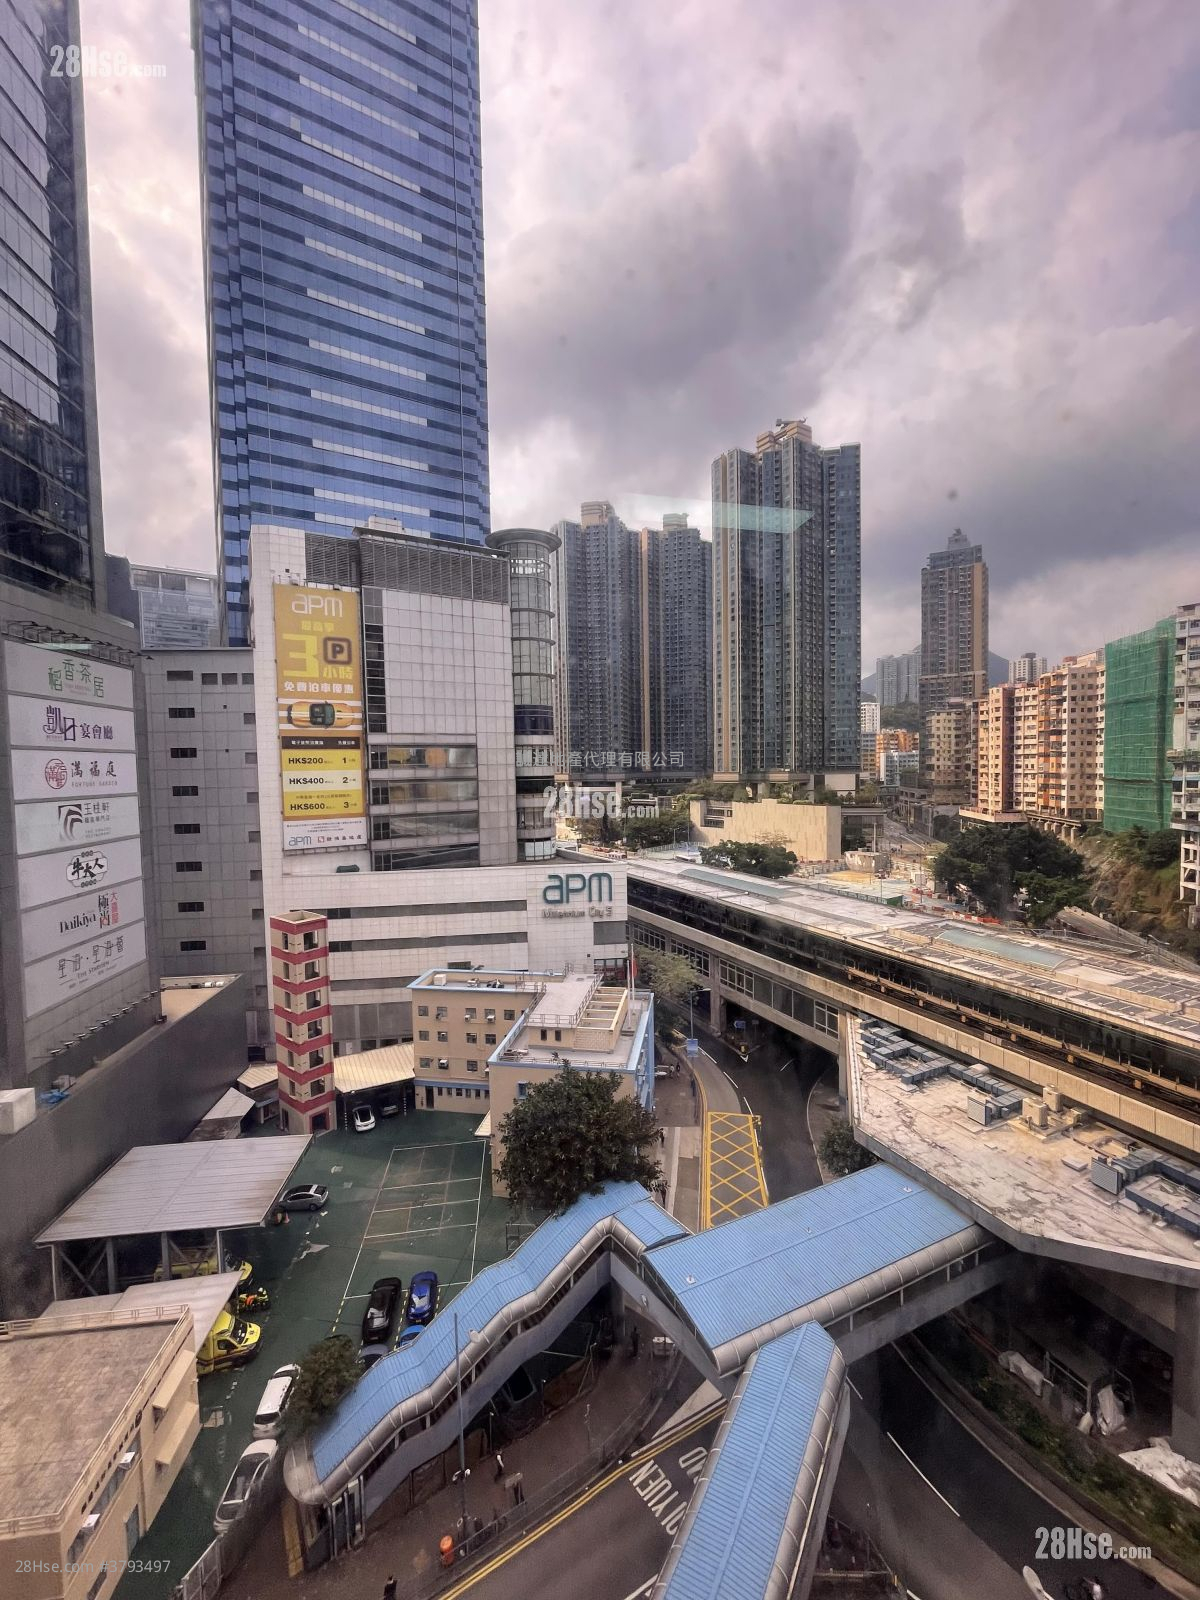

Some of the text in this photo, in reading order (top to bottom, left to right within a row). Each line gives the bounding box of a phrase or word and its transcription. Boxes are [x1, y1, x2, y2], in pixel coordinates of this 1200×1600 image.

[282, 633, 319, 677] 3
[331, 643, 344, 659] P
[343, 801, 350, 809] 3
[71, 857, 104, 879] 牛大人
[588, 905, 604, 919] City
[629, 1459, 679, 1517] YUEN
